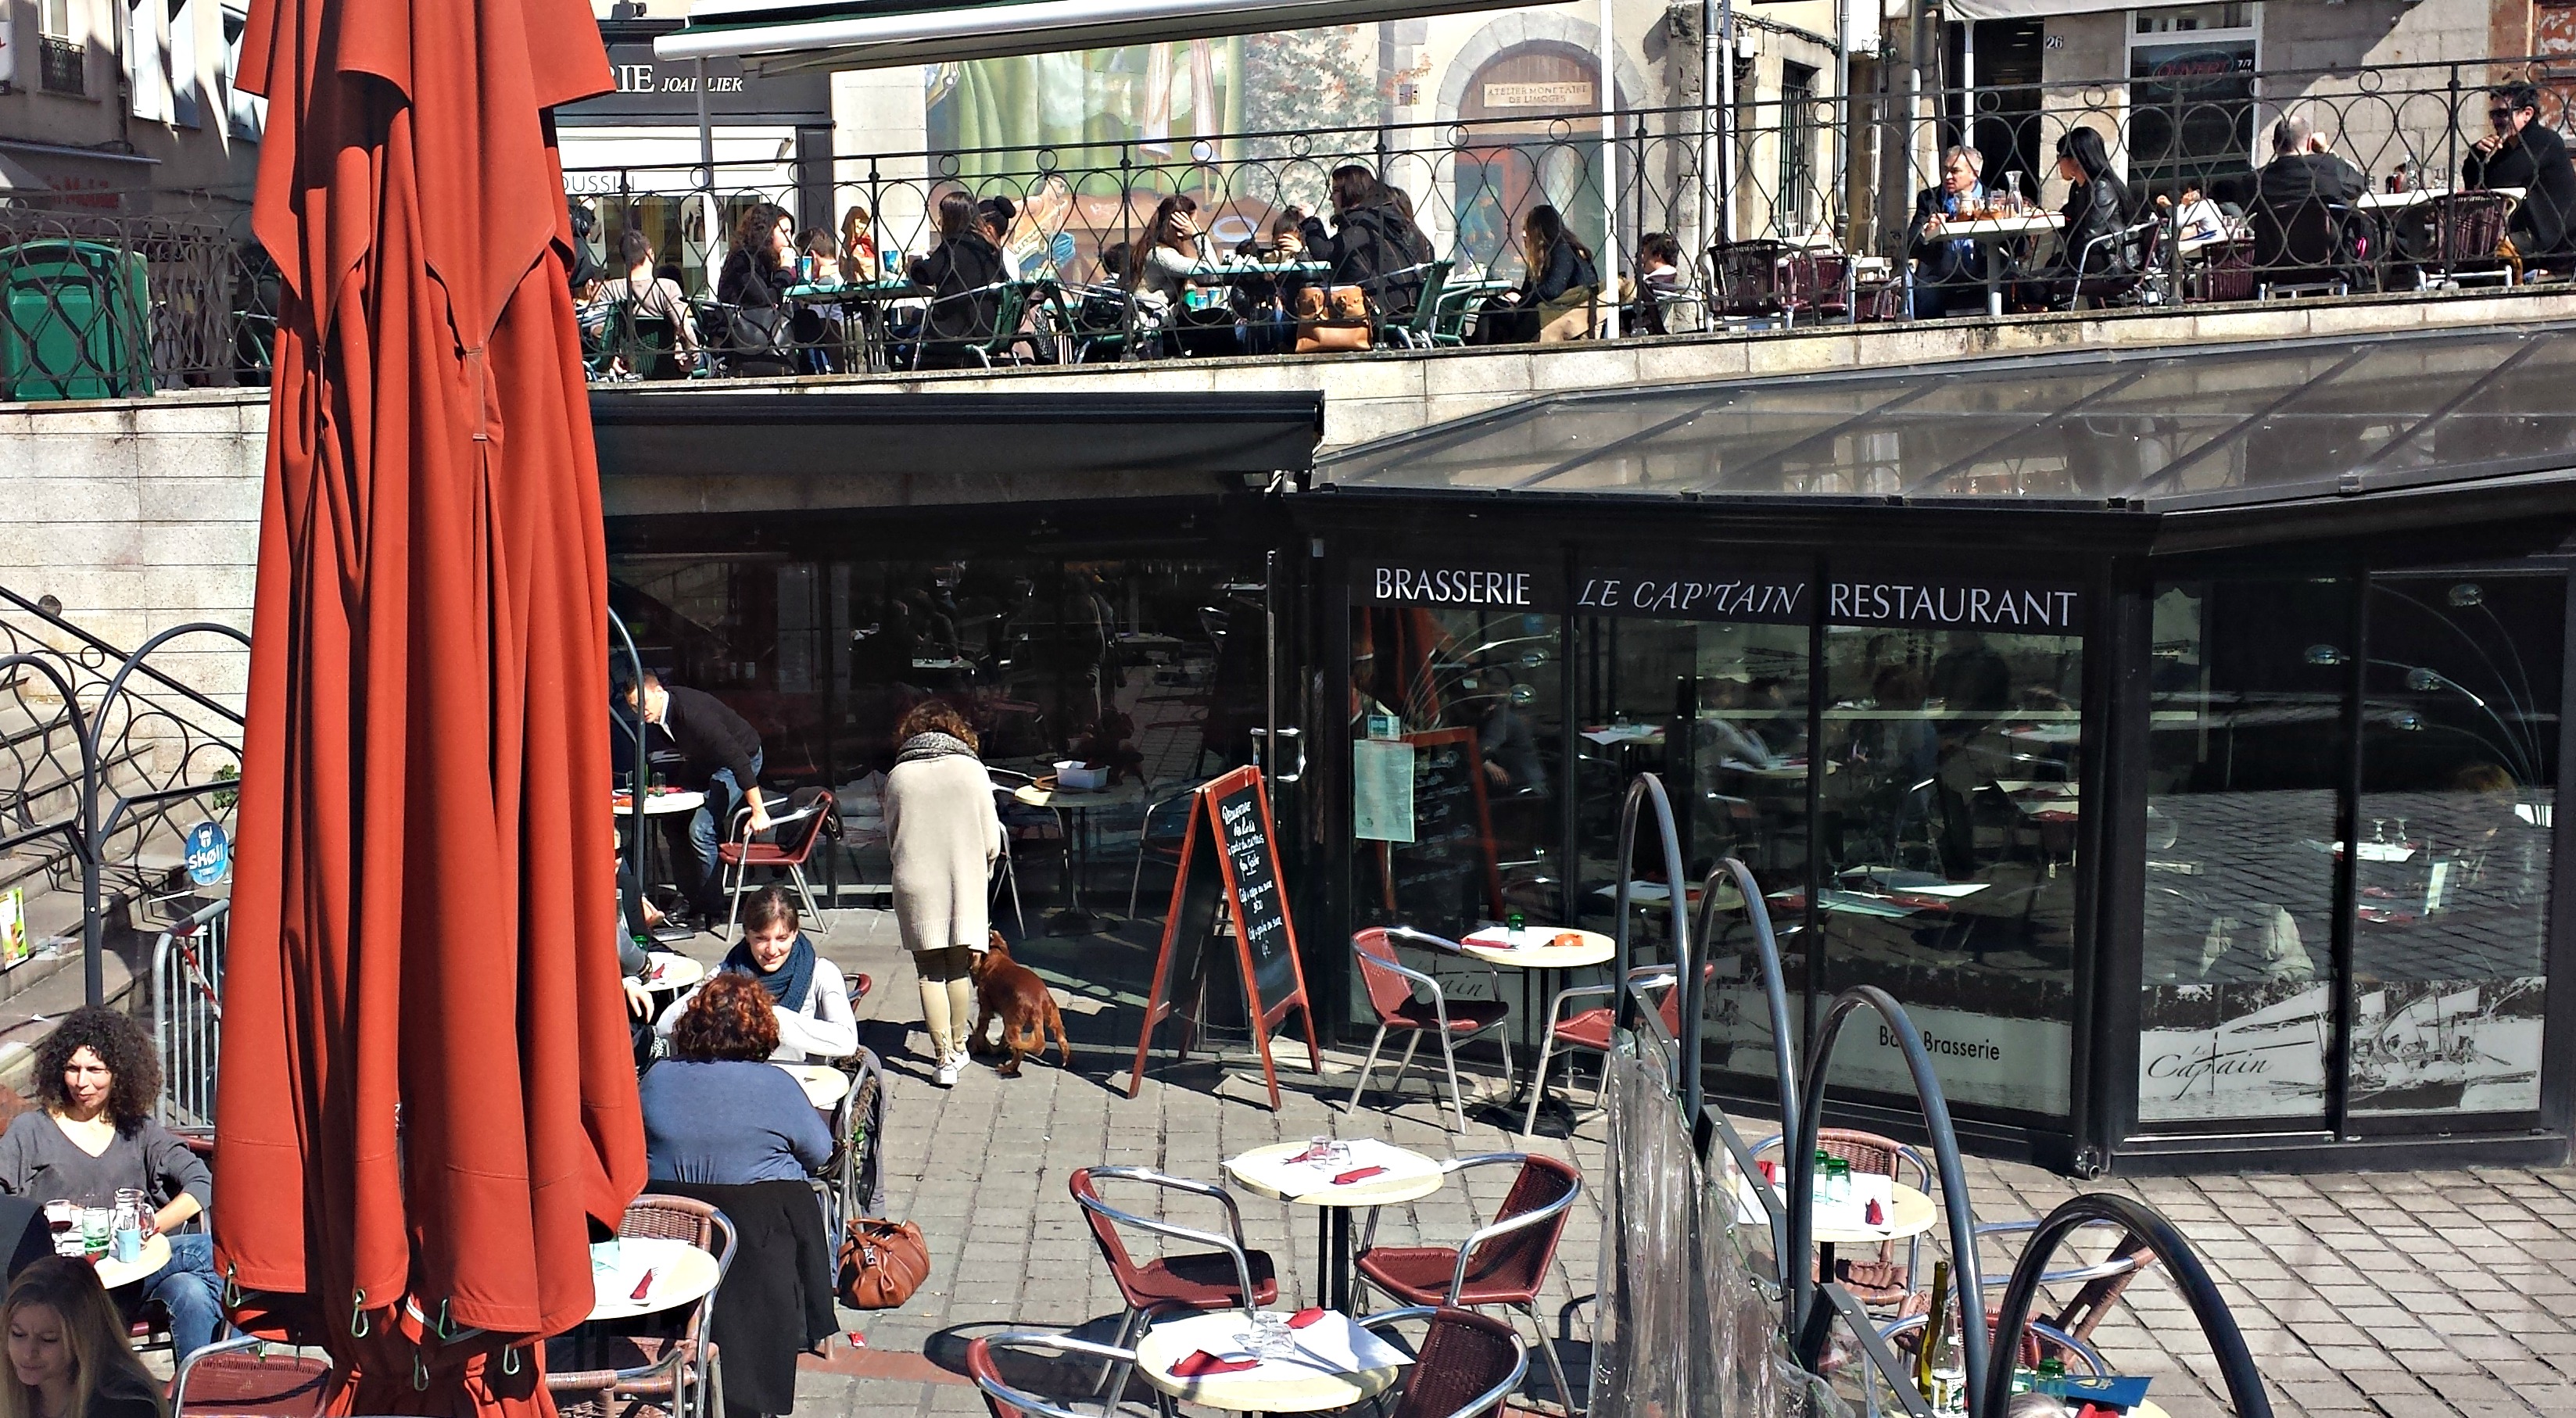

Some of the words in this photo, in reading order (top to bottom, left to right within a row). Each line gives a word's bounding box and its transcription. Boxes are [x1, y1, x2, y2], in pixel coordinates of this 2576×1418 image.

[2047, 36, 2063, 49] 26
[661, 77, 743, 93] JOAILIER
[1488, 87, 1527, 96] ATELIER
[1524, 95, 1567, 103] LIMOGES
[1375, 568, 1532, 606] BRASSERIE
[1577, 578, 1621, 607] LE
[1633, 579, 1806, 615] CAP'TAIN
[1830, 582, 2078, 627] RESTAURANT
[1879, 1025, 1901, 1047] Ba
[1923, 1030, 2000, 1061] Brasserie
[2148, 1044, 2274, 1101] Captain
